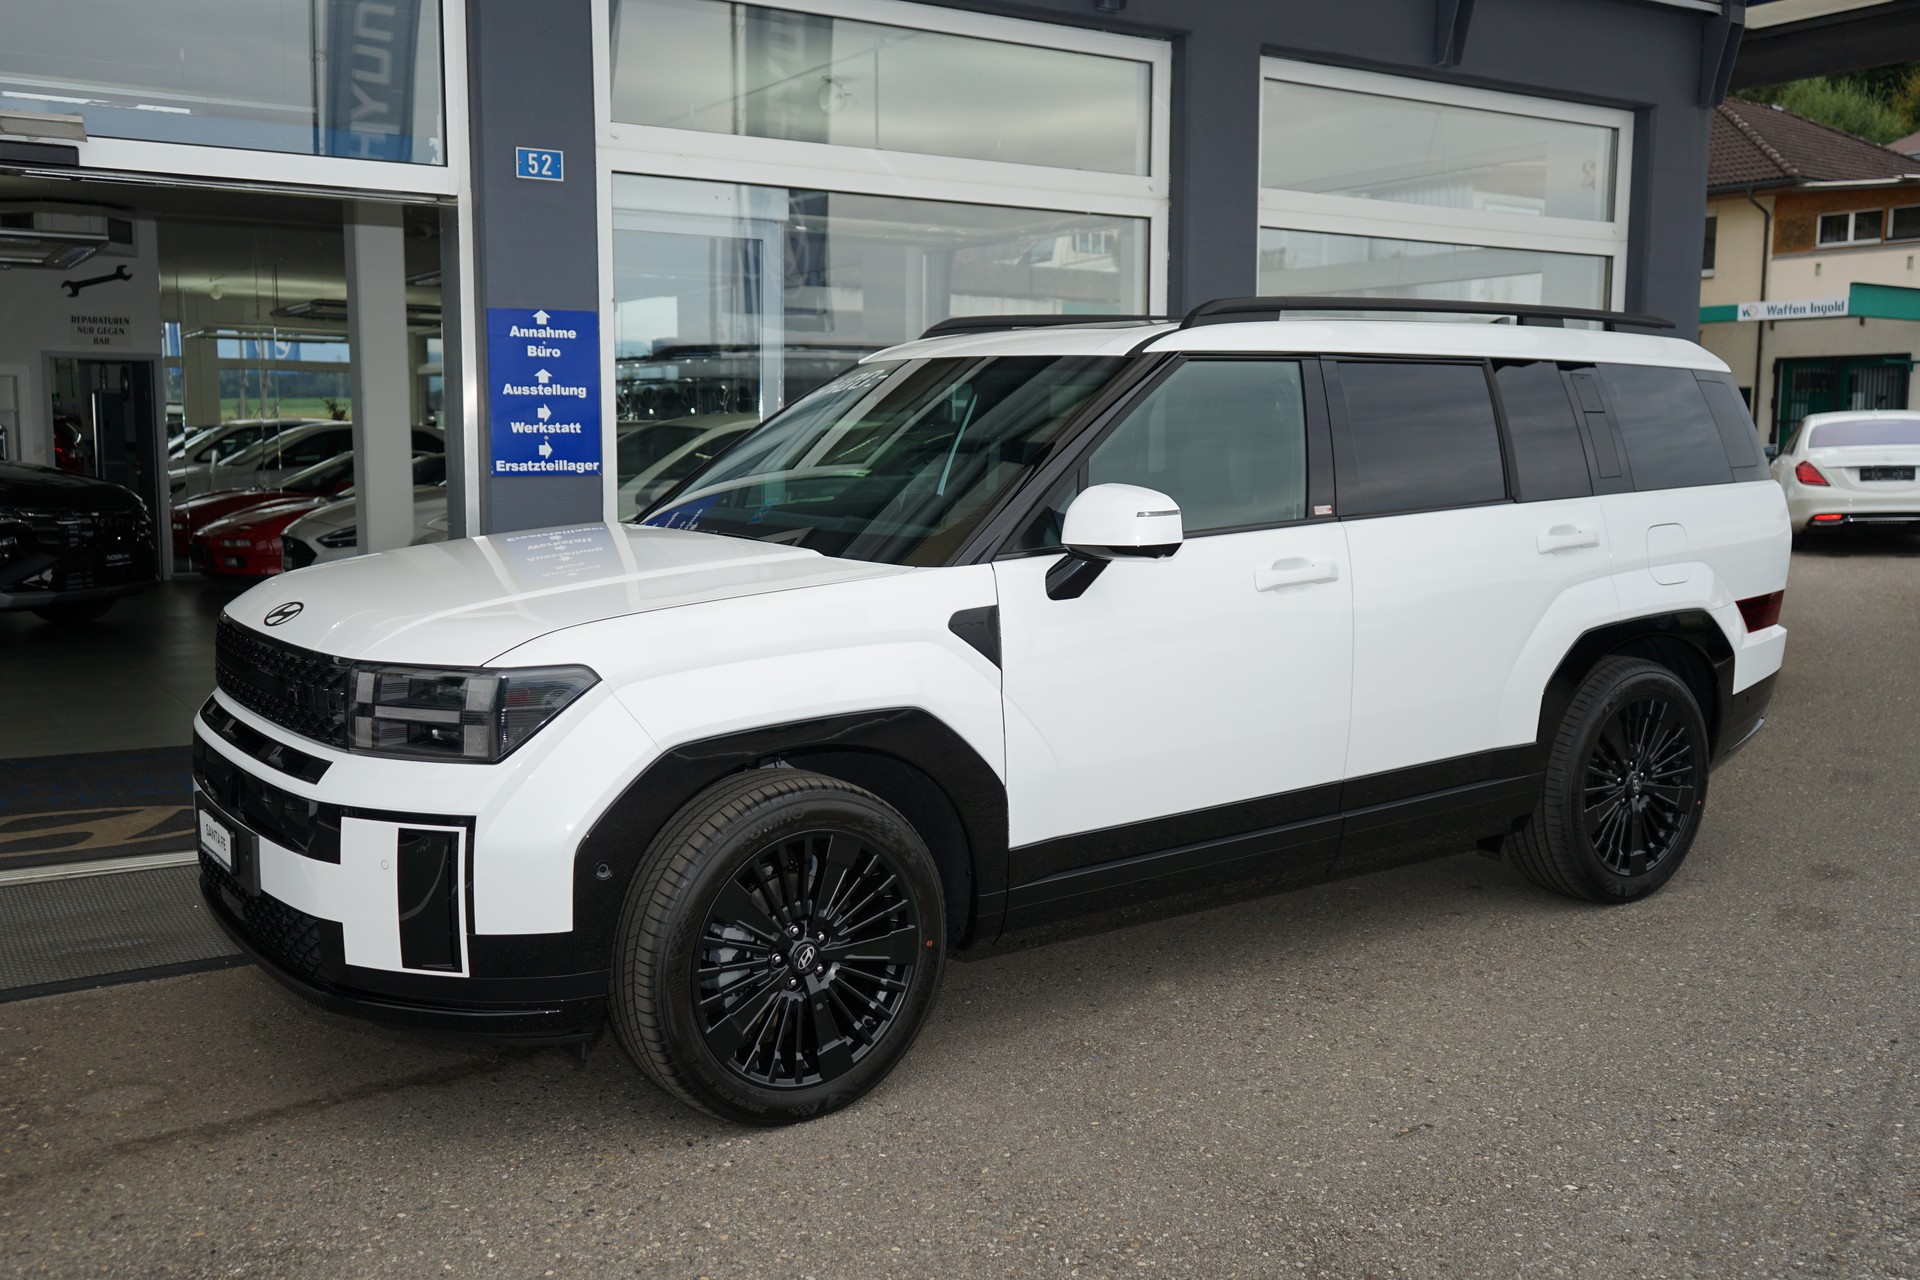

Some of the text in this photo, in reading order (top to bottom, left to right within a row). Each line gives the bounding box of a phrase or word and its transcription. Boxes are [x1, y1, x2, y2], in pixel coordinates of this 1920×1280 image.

[528, 152, 552, 175] 52
[1766, 300, 1845, 316] Waffen Ingold
[71, 315, 130, 325] REPARATUREN
[77, 326, 125, 335] NUR GEGEN
[509, 325, 577, 339] Annahme
[93, 337, 110, 345] BAR
[527, 344, 561, 358] Büro
[502, 383, 587, 398] Ausstellung
[510, 422, 582, 434] Werkstatt
[495, 460, 600, 473] Ersatzteillager
